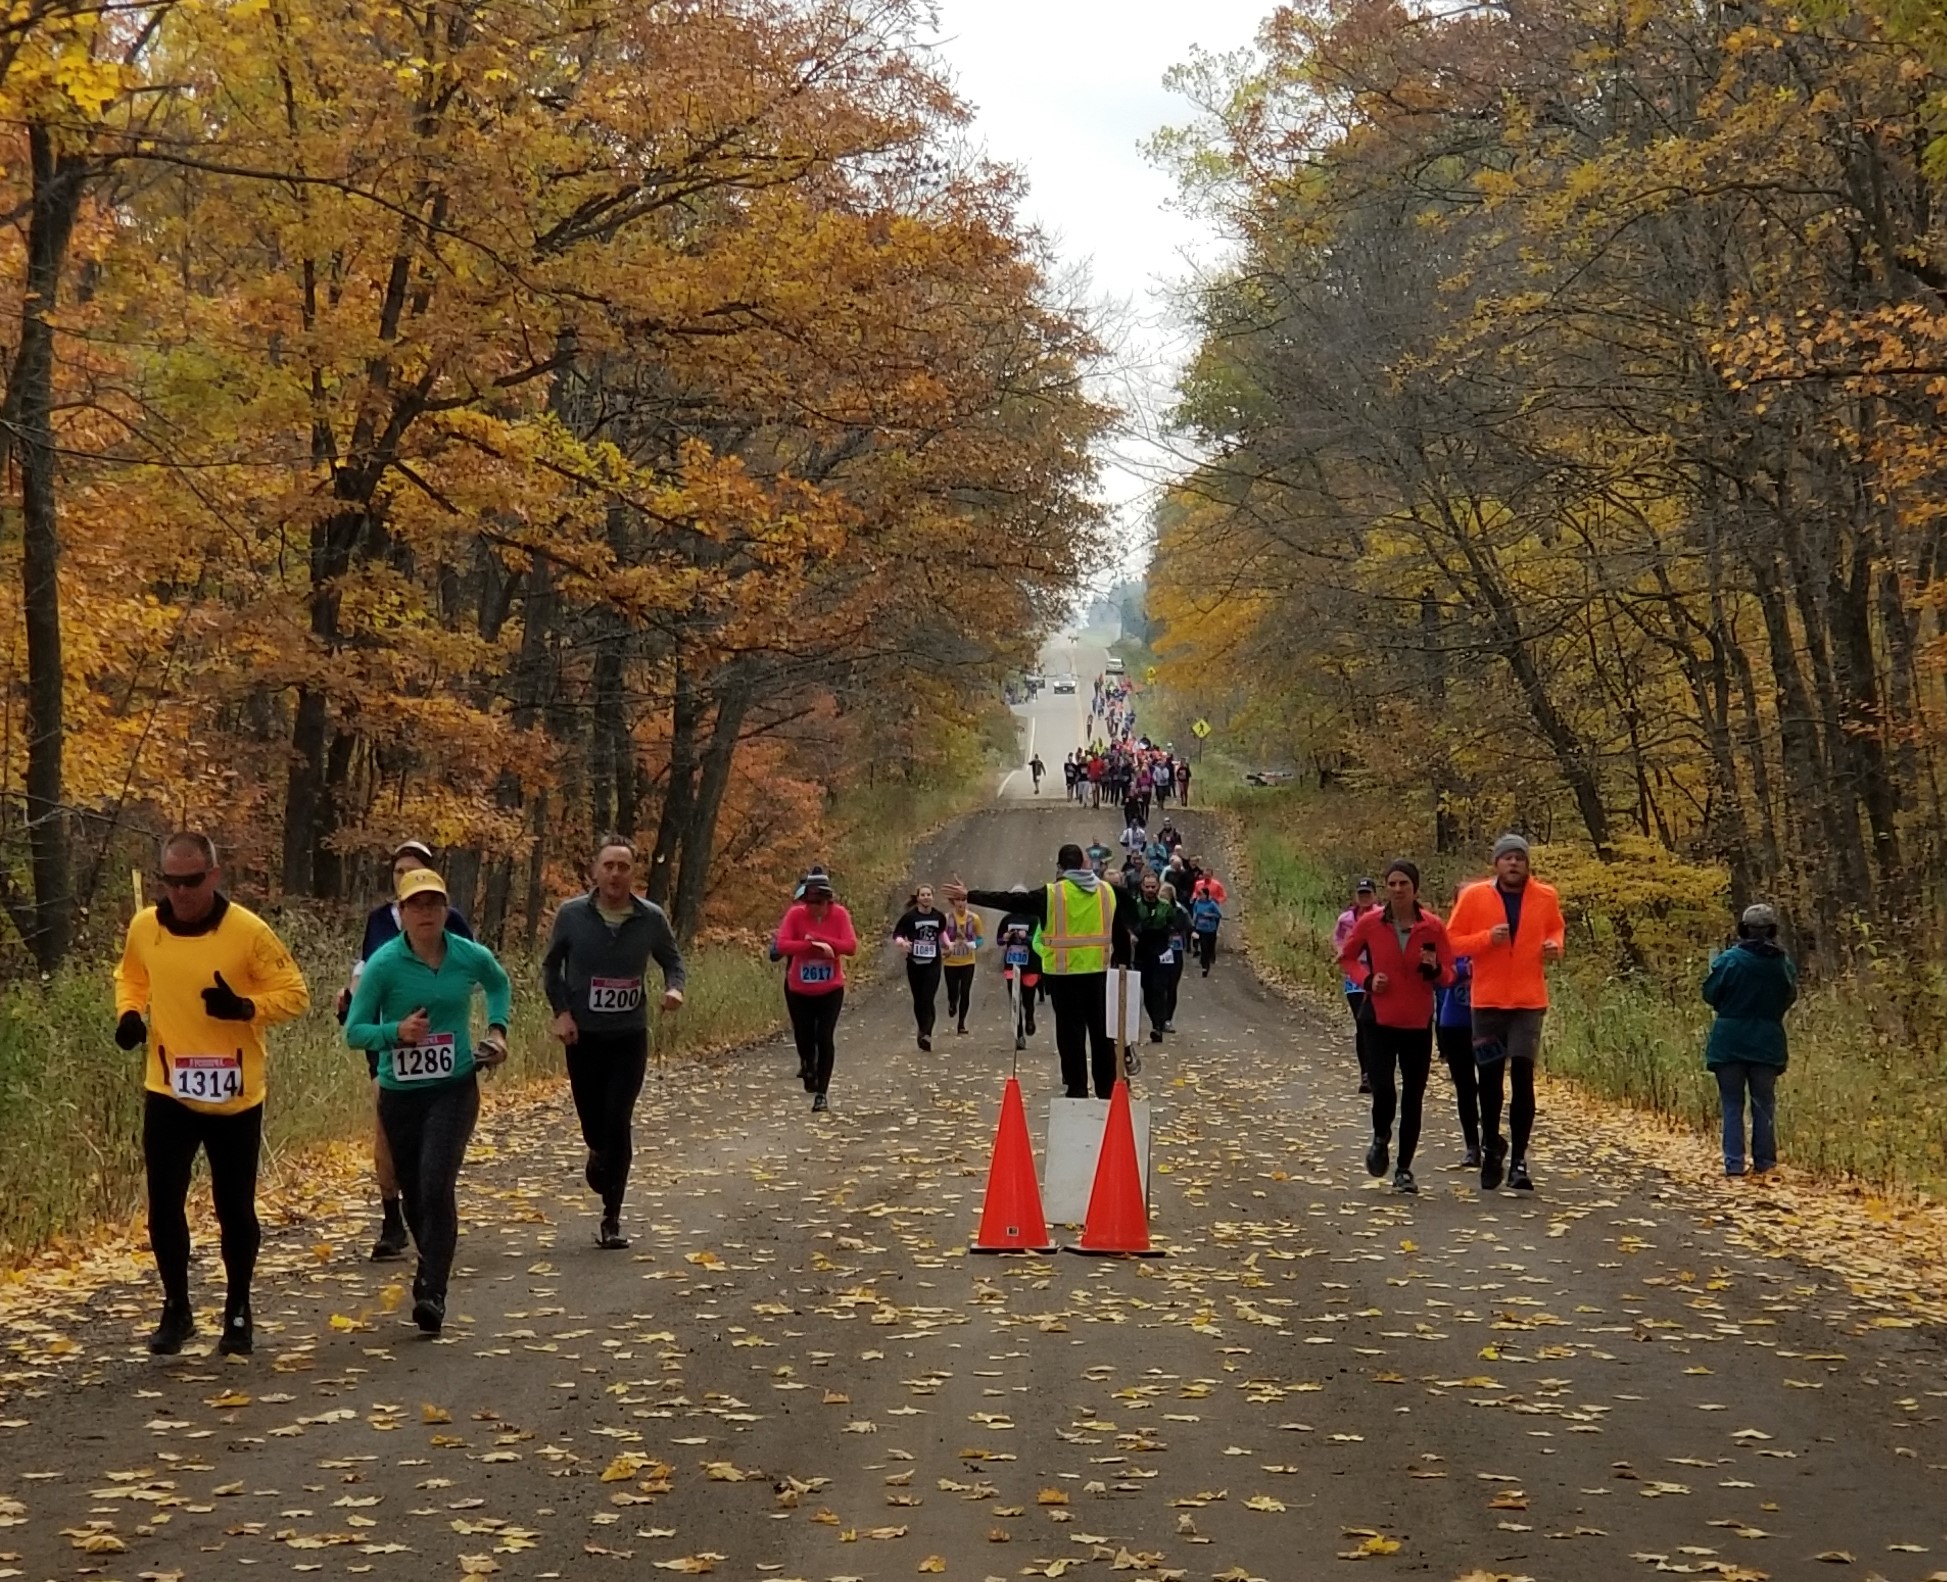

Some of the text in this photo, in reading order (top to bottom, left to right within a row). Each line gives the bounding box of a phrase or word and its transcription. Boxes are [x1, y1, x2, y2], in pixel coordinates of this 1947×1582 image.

[593, 989, 639, 1008] 1200
[397, 1047, 452, 1076] 1286
[178, 1070, 238, 1098] 1314
